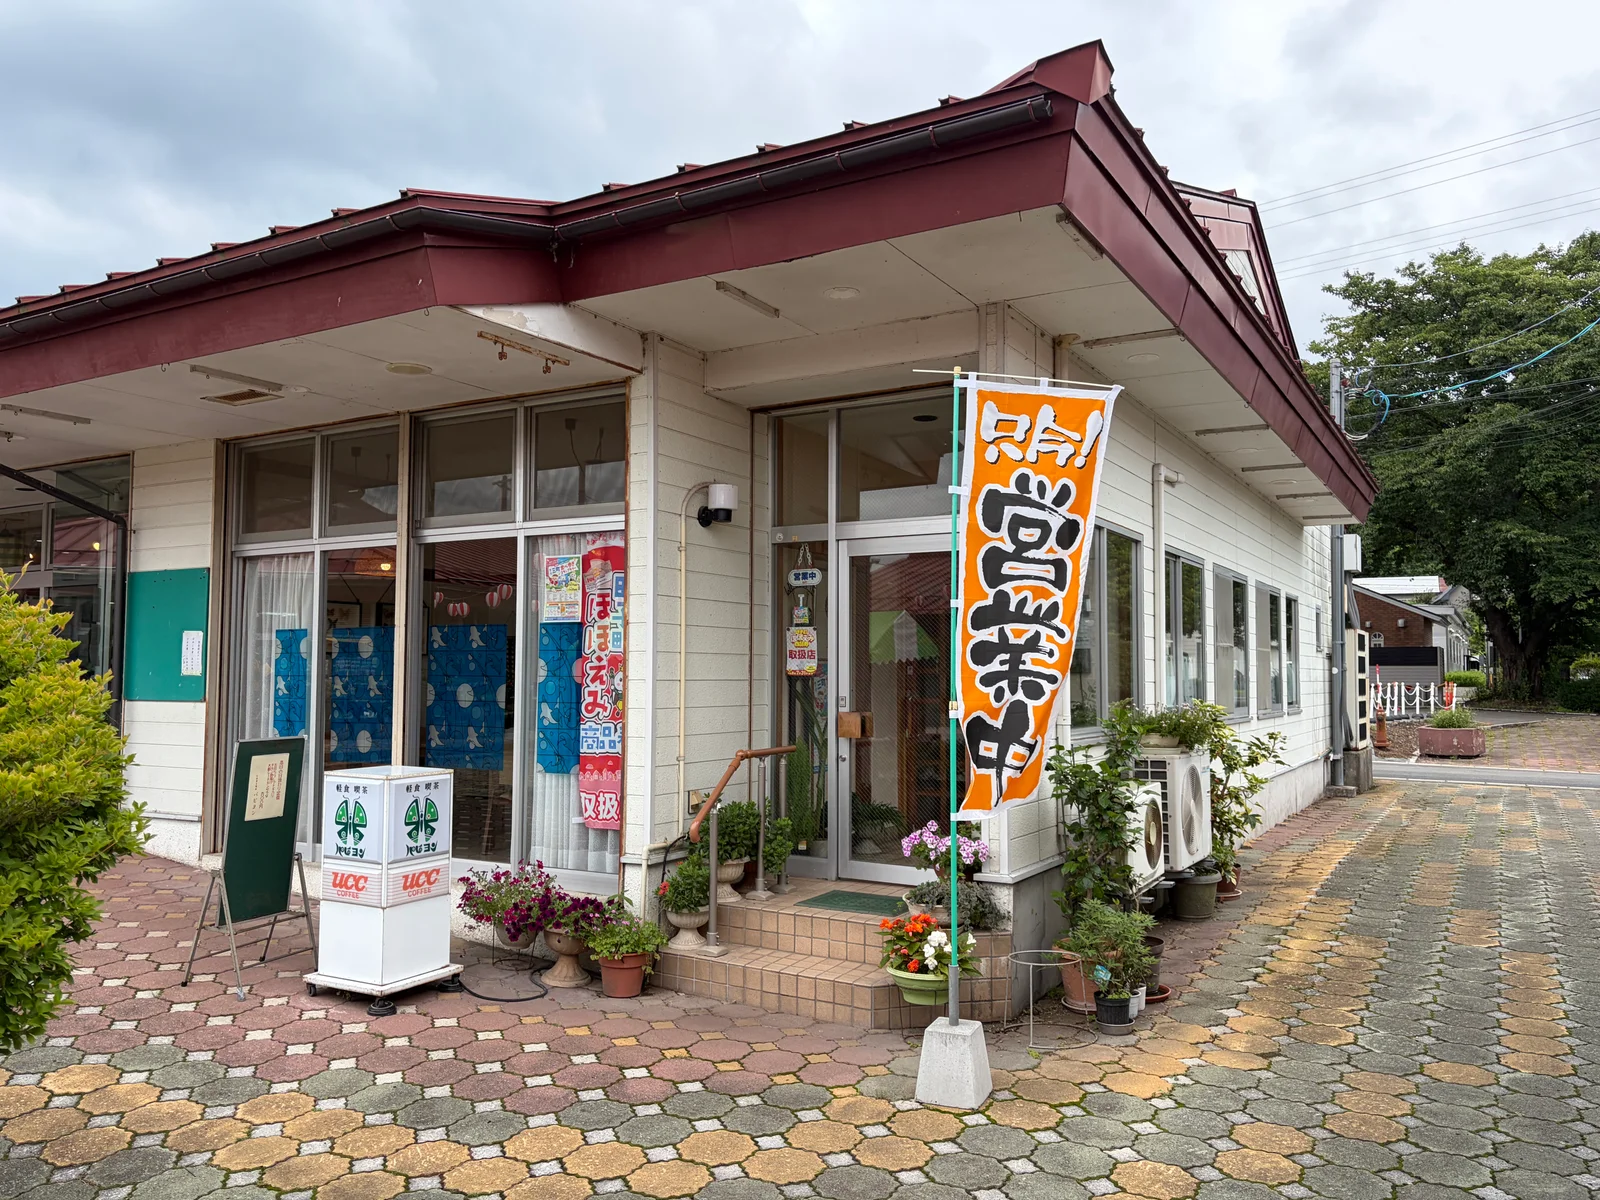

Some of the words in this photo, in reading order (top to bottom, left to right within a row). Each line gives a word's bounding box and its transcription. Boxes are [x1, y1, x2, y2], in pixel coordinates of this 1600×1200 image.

[793, 571, 817, 582] 営業中
[966, 472, 1082, 808] 営業中
[584, 592, 611, 717] ほほえみ
[788, 649, 816, 660] 取扱店
[580, 725, 623, 750] 商品
[336, 784, 350, 793] 軽食
[353, 785, 368, 795] 喫茶
[406, 783, 421, 793] 軽食
[424, 781, 440, 791] 喫茶
[331, 871, 369, 892] UCC
[402, 868, 441, 891] UCC
[336, 889, 360, 899] COFFEE
[407, 887, 432, 898] COFFEE
